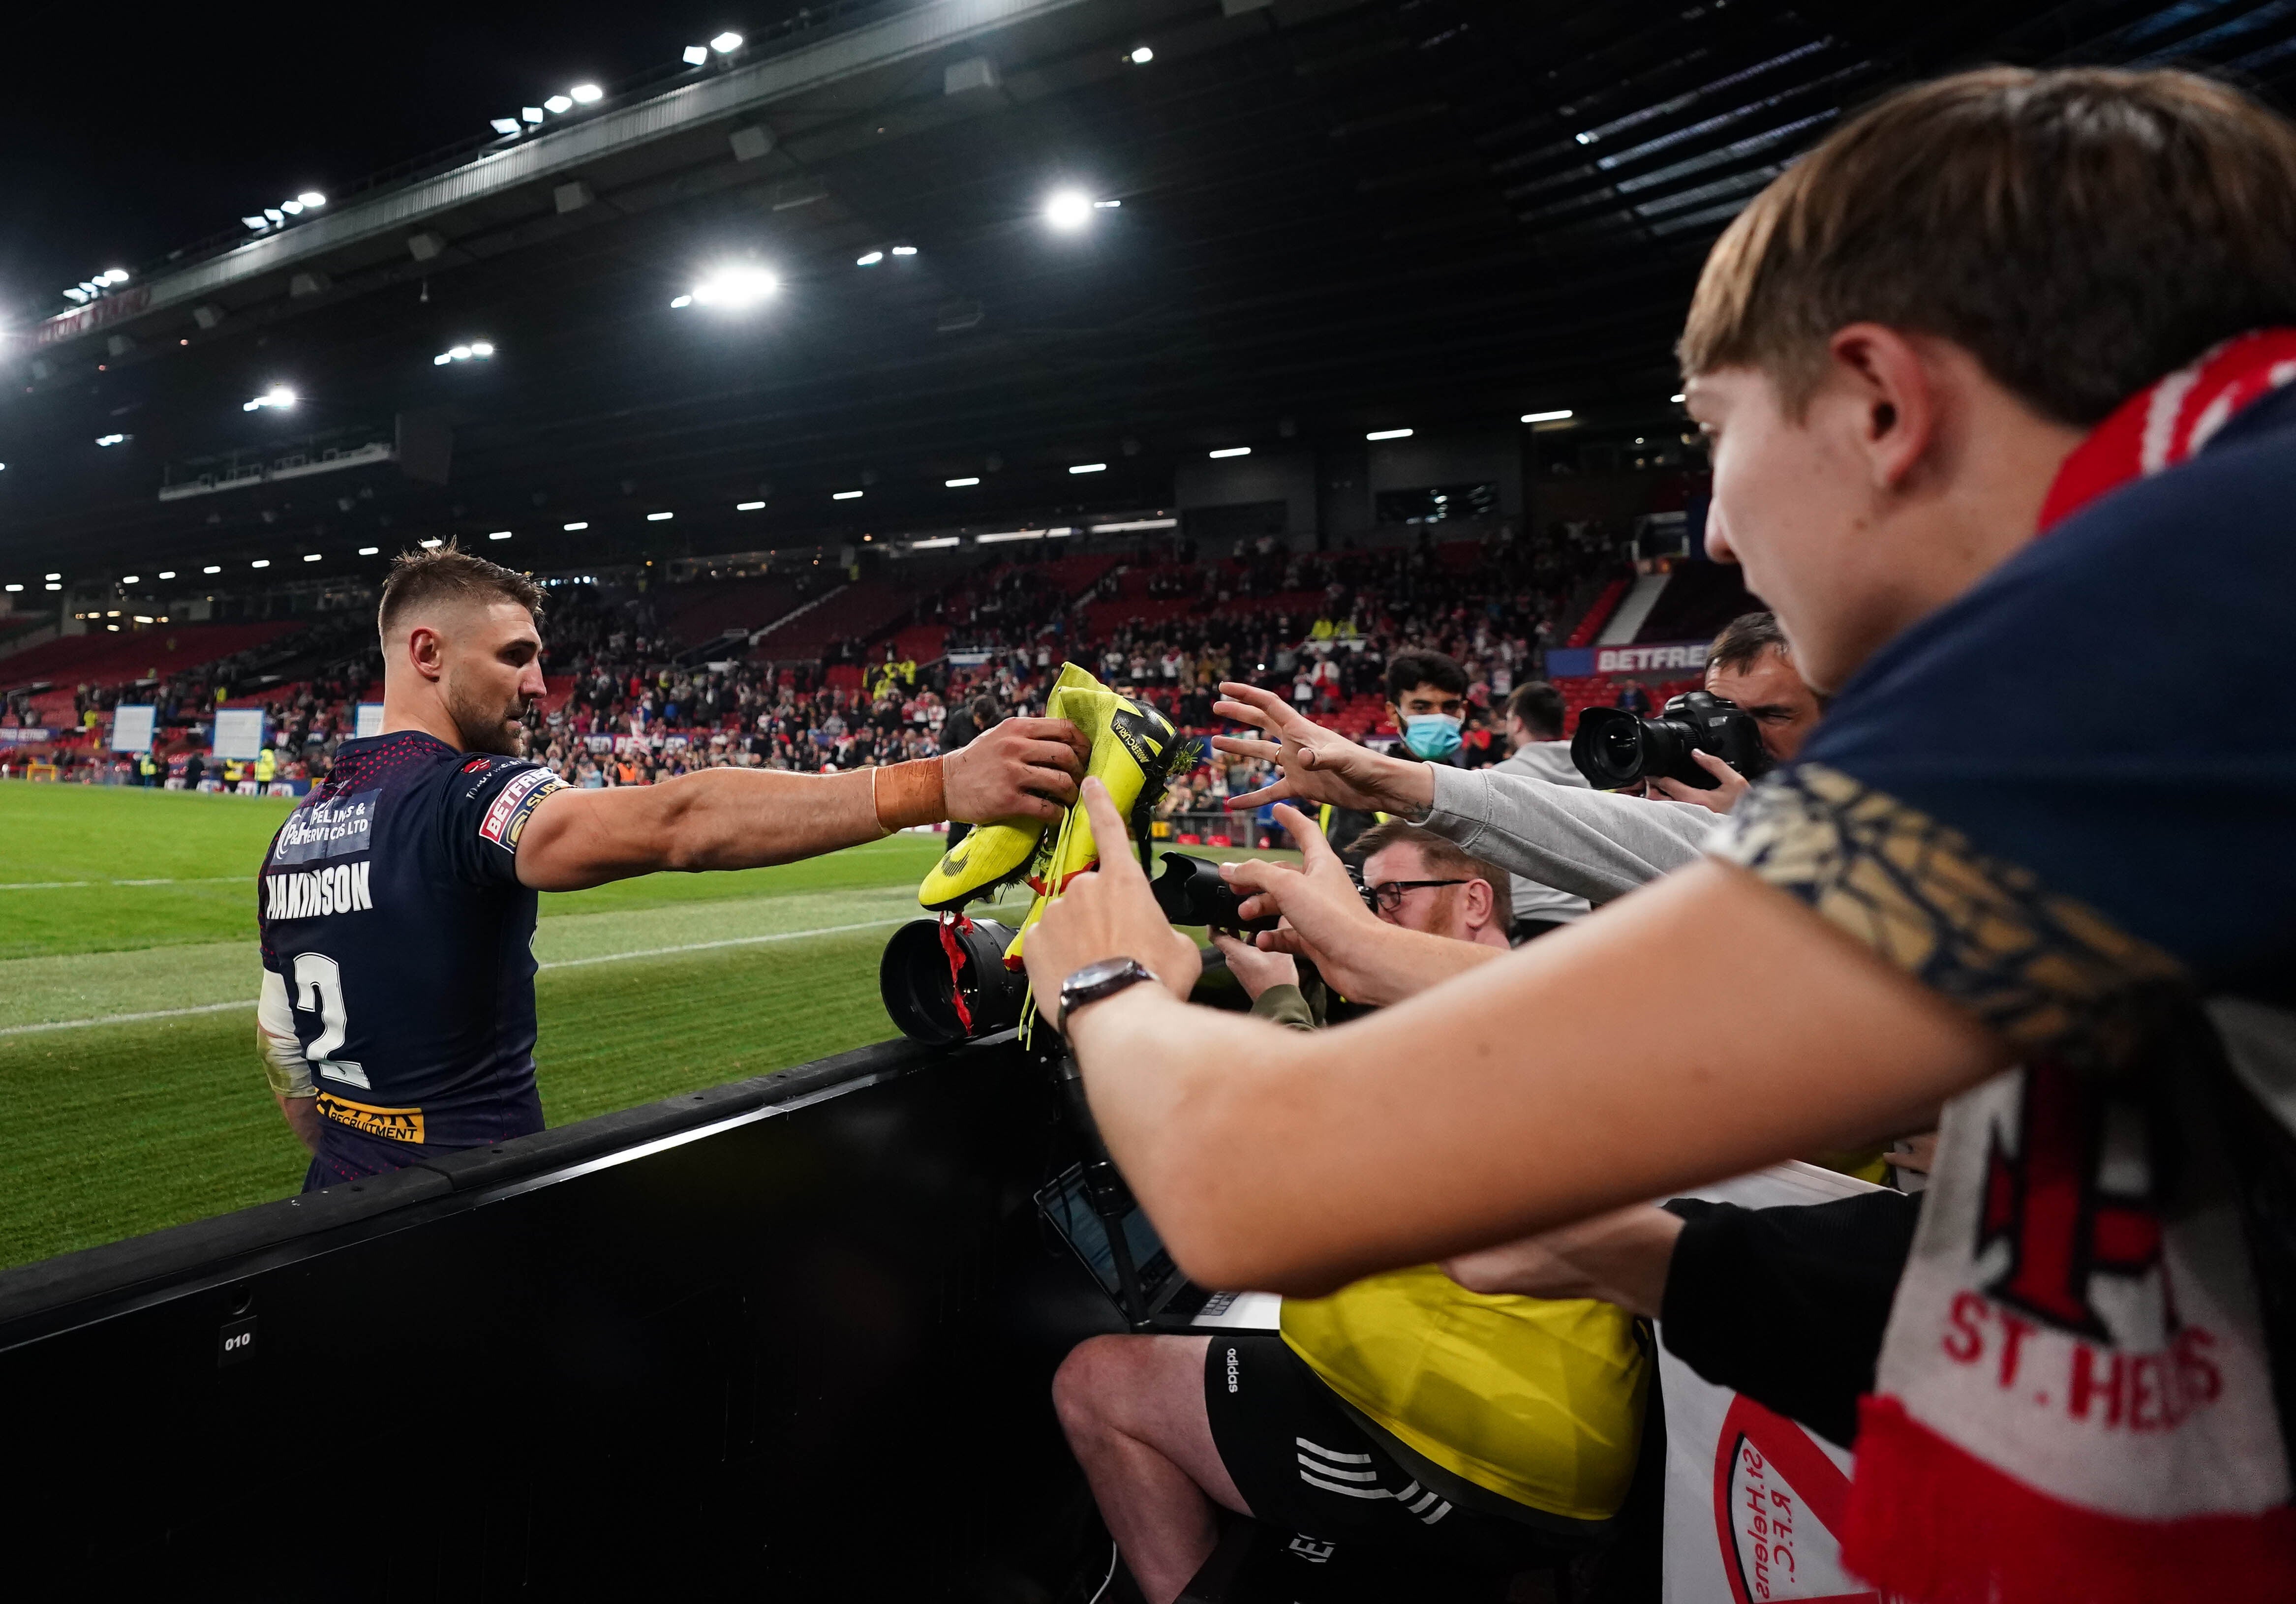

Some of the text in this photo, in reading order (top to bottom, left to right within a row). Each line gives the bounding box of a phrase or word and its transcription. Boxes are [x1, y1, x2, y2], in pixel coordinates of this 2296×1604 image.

[1597, 644, 1707, 672] BETFRE
[486, 768, 552, 837] BETFRE
[347, 818, 368, 835] LTD
[293, 952, 371, 1090] 2
[331, 1112, 417, 1140] RECRUITMENT
[225, 1332, 250, 1351] 010
[1227, 1348, 1239, 1393] adidas
